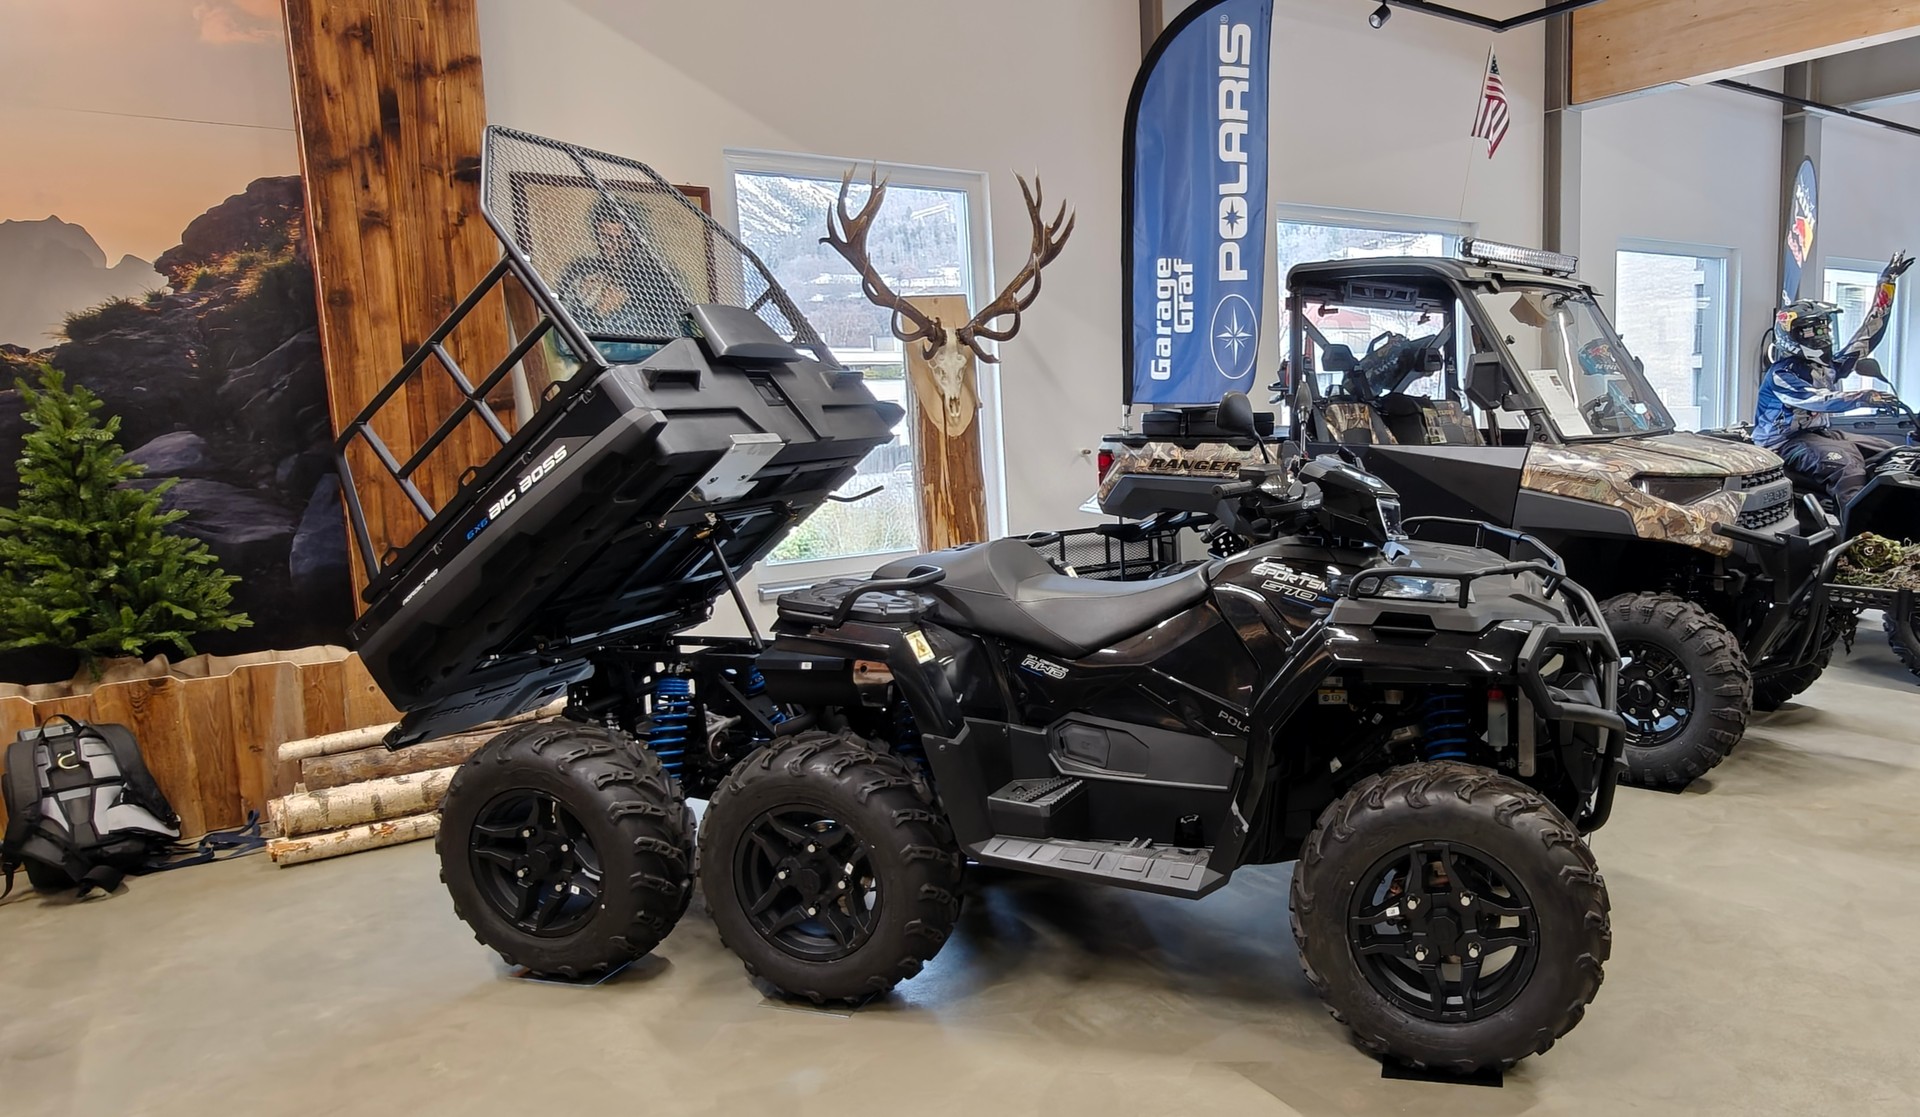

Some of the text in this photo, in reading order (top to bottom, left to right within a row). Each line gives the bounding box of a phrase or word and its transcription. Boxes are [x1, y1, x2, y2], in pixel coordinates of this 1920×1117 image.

[1218, 22, 1251, 282] POLARIS
[1173, 258, 1194, 333] Graf
[1150, 257, 1177, 380] Garage
[1149, 457, 1241, 472] RANGER
[488, 488, 517, 521] BIG
[519, 445, 568, 494] BOSS
[1251, 564, 1328, 592] SPORTSM
[1261, 580, 1318, 601] 570
[1021, 657, 1067, 680] AWD
[1218, 710, 1250, 733] POLA
